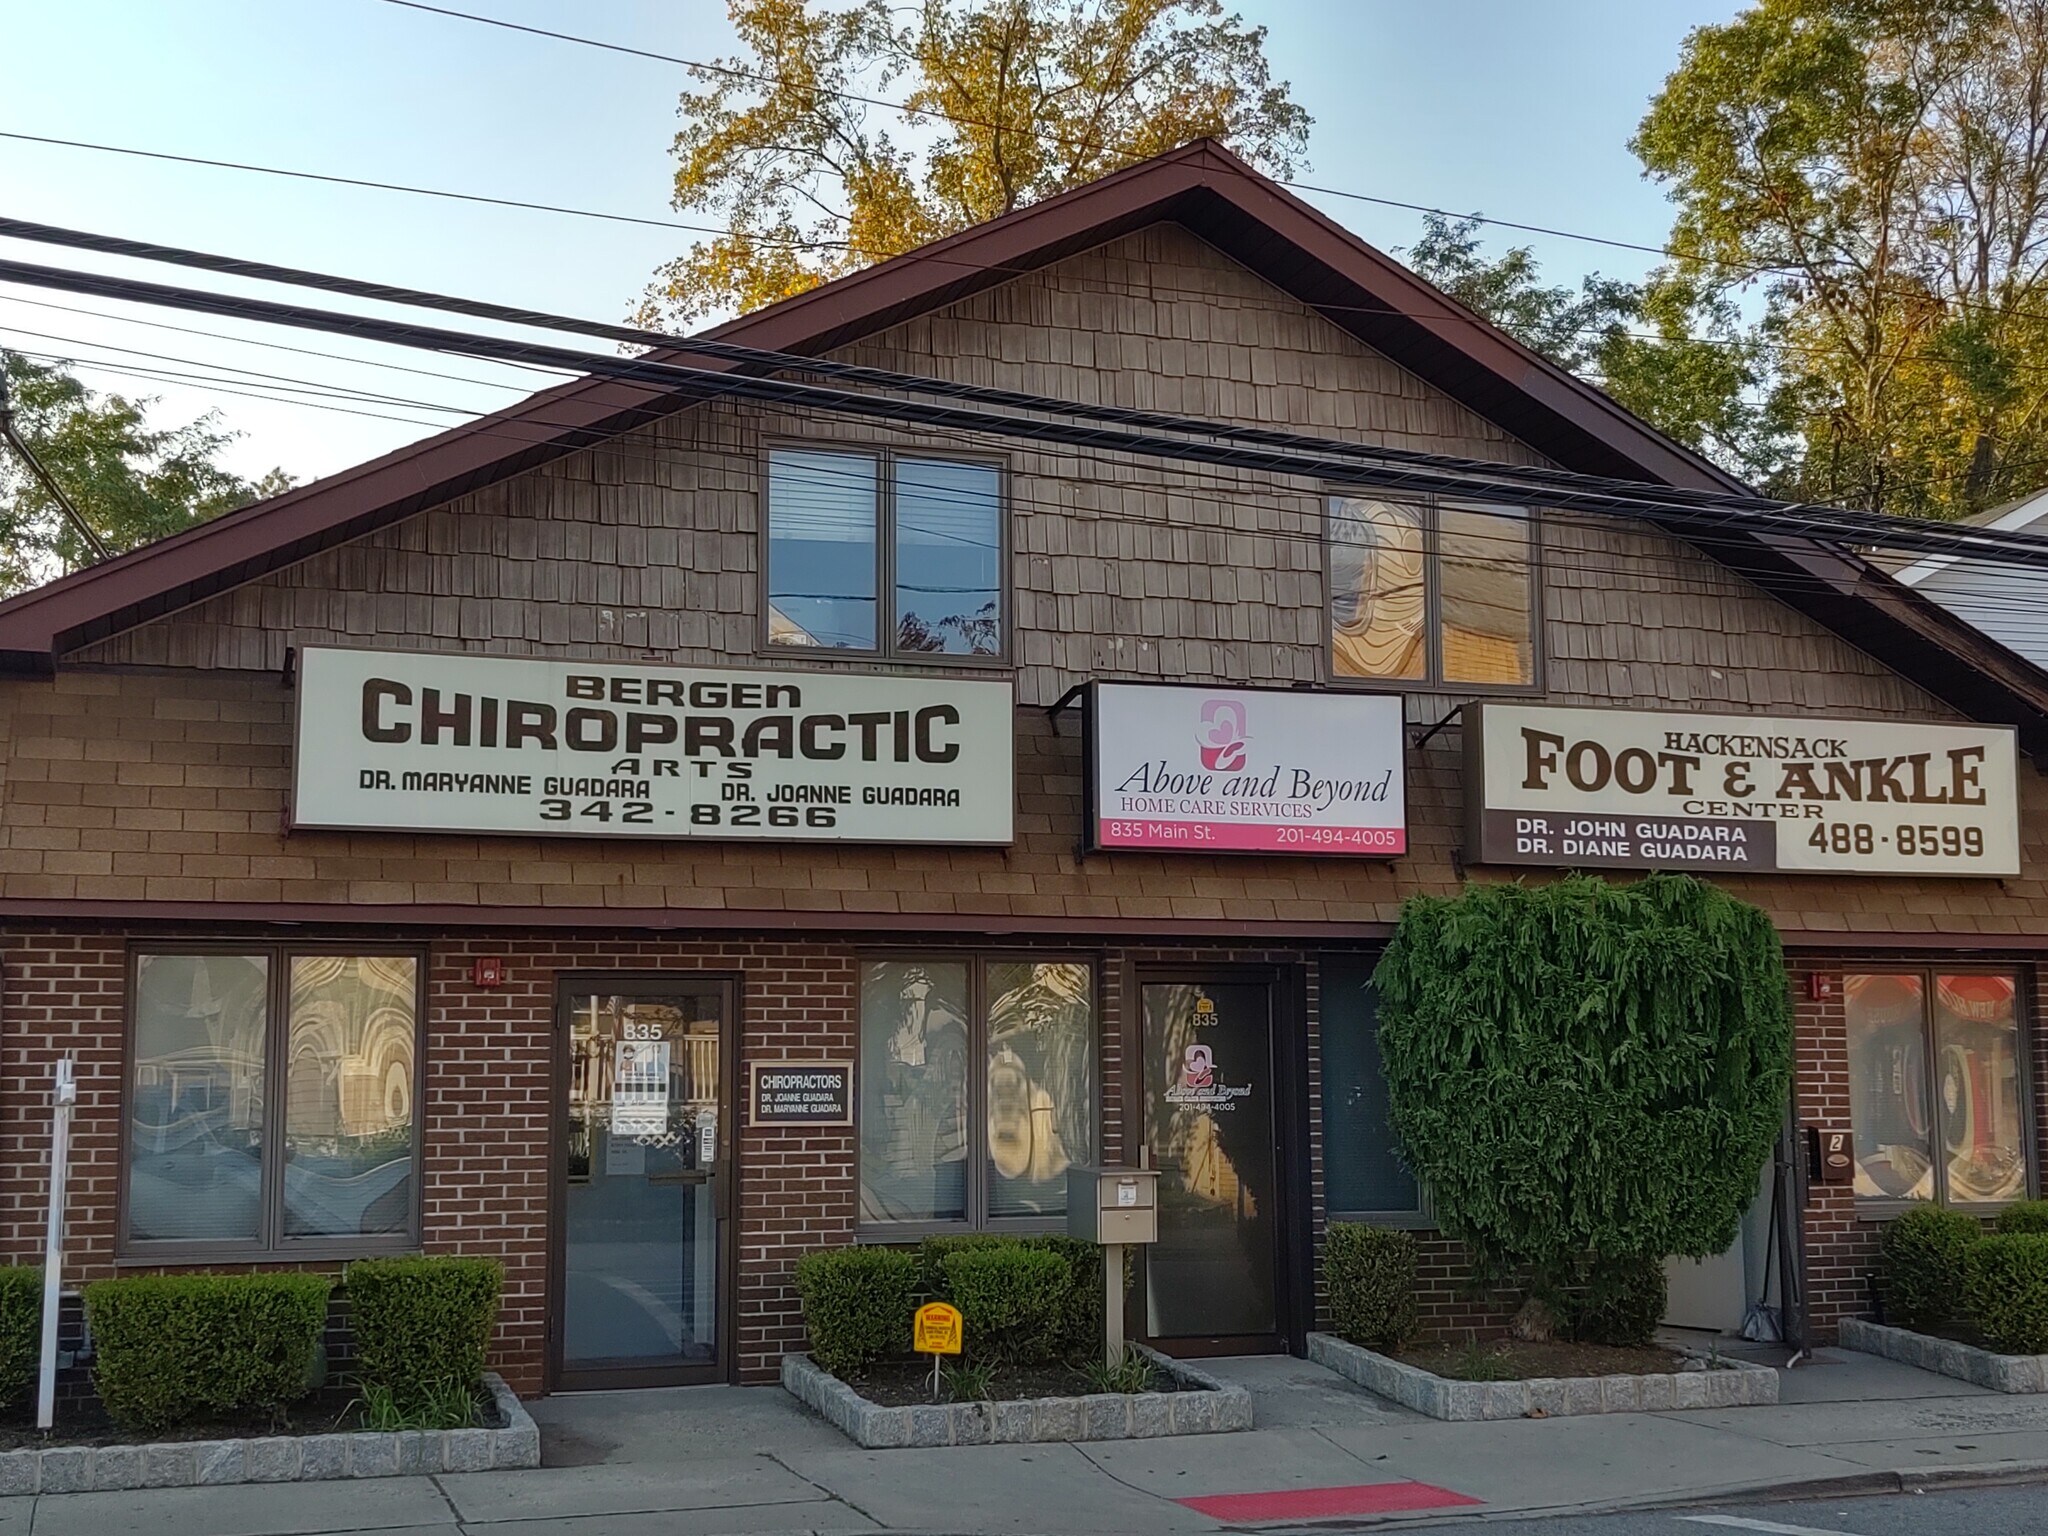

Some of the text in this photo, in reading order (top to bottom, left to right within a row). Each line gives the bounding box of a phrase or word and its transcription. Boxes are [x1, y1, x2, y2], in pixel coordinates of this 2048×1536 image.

[565, 674, 802, 709] BERGEN
[362, 677, 961, 764] CHIROPRACTIC
[1664, 732, 1847, 758] HACKENSACK
[611, 758, 753, 779] ARTS
[1521, 727, 1987, 806] FOOT & ANKLE
[359, 769, 650, 800] DR. MARYANNE GUADARA
[721, 782, 961, 808] DR. JOANNE GUADARA
[1115, 760, 1392, 811] Above and Beyond
[539, 799, 837, 828] 342-8266
[1121, 797, 1312, 818] HOME CARE SERVICES
[1683, 800, 1824, 819] CENTER
[1111, 823, 1216, 841] 835 Main St.
[1276, 828, 1396, 846] 201-494-4005
[1516, 819, 1747, 842] DR. JOHN GUADARA
[1516, 838, 1748, 861] DR. DIANE GUADARA
[1193, 1013, 1218, 1026] 835
[624, 1024, 662, 1040] 835
[761, 1075, 842, 1089] CHIROPRACTORS
[761, 1093, 834, 1102] DR. JOANNE GUADARA
[773, 1104, 809, 1113] MARYANNE
[810, 1104, 842, 1113] GUADARA
[1832, 1136, 1841, 1150] 2
